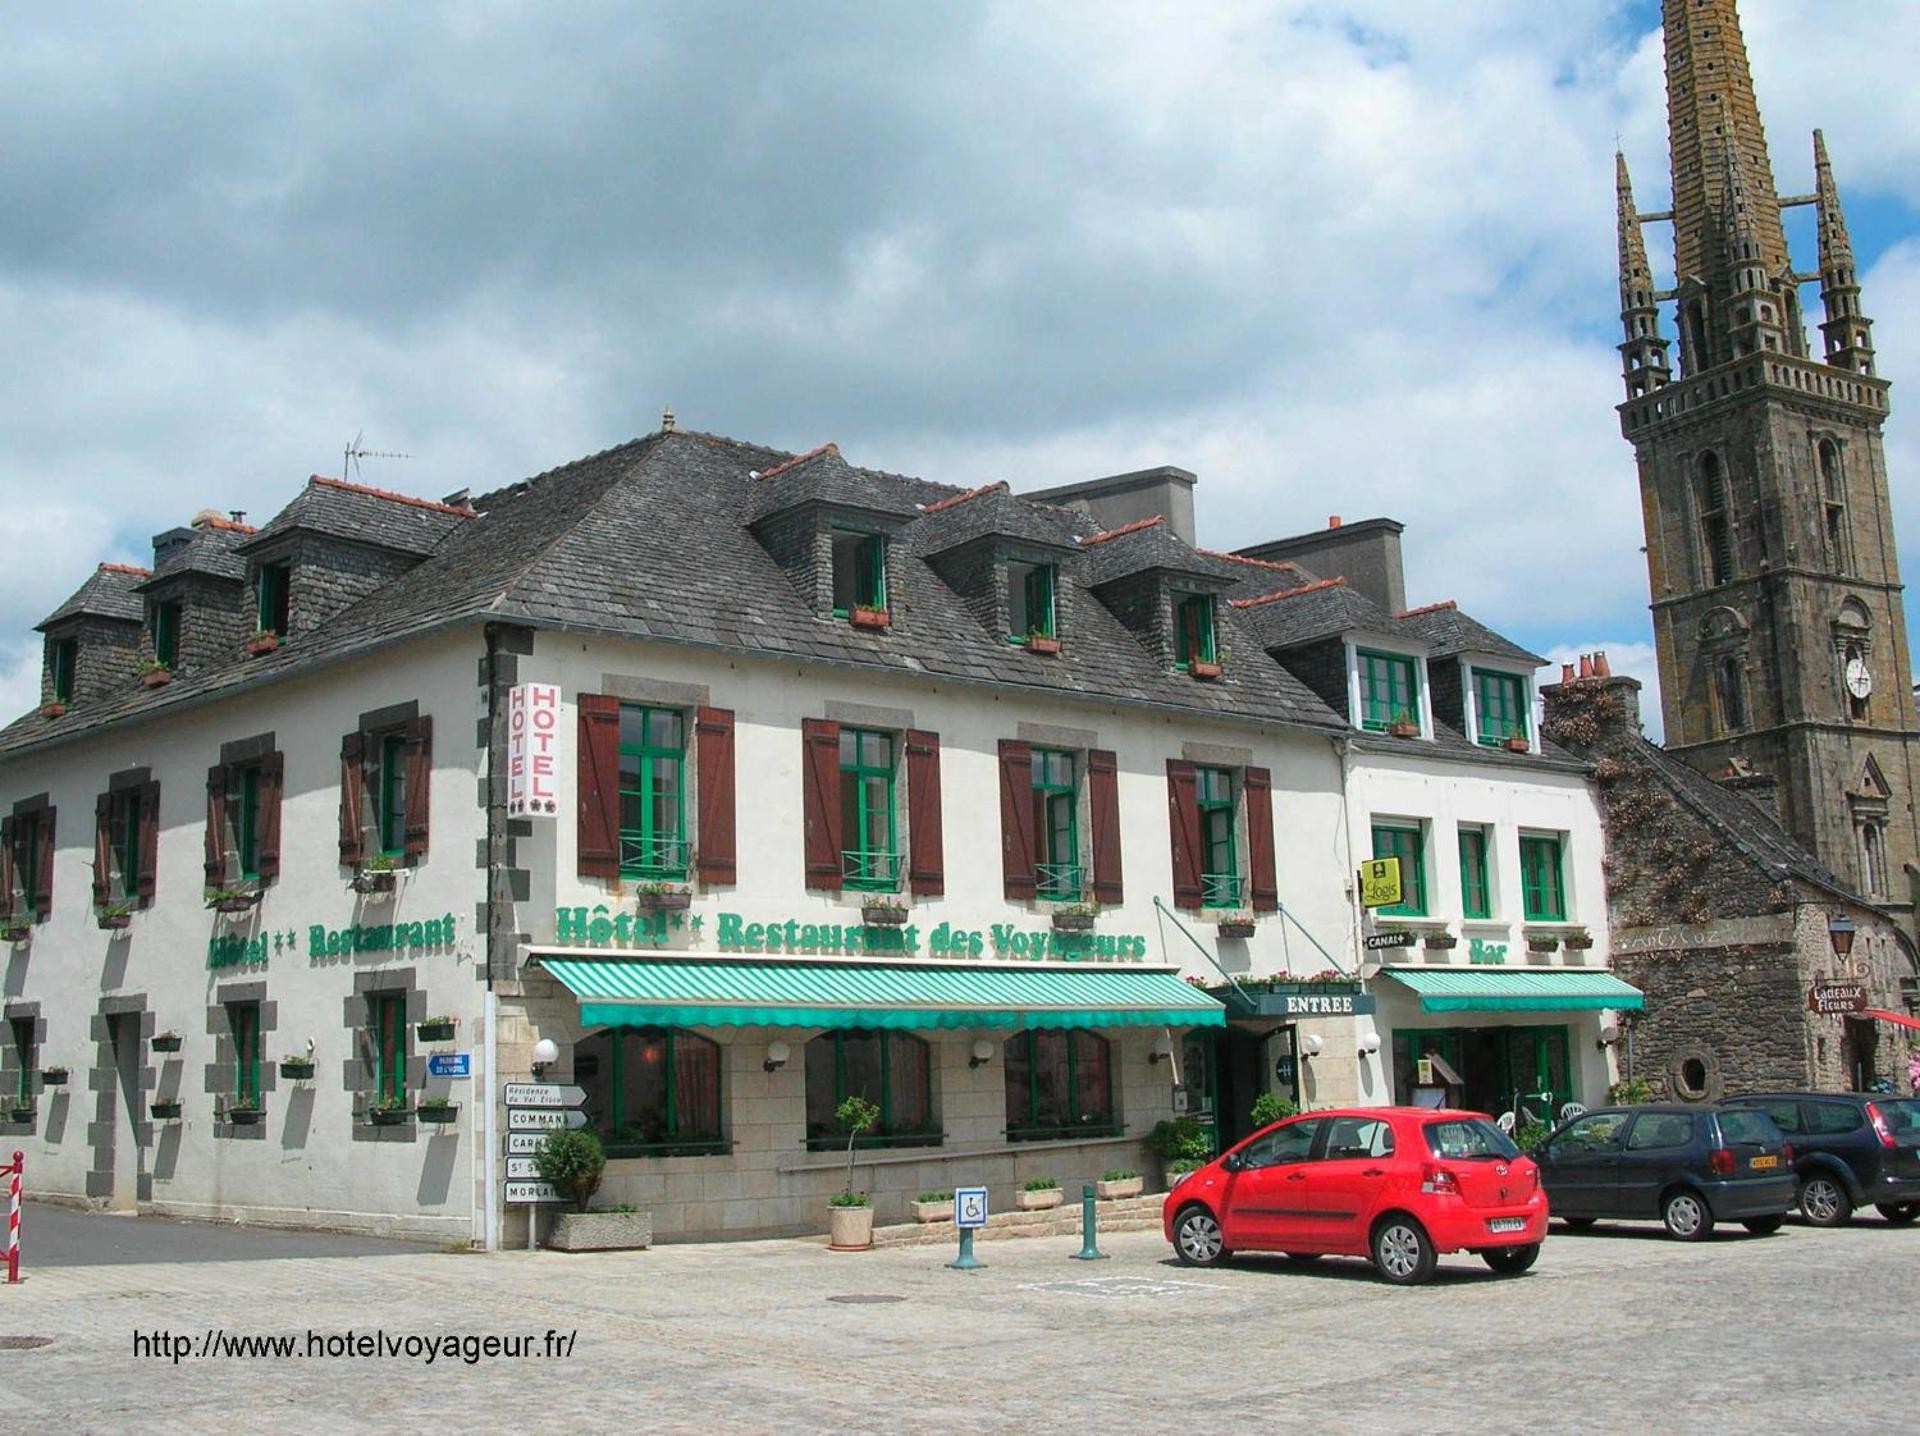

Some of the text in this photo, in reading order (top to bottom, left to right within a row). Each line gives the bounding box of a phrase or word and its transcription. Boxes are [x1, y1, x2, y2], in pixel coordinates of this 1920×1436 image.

[512, 686, 525, 800] HOTEL
[533, 686, 556, 797] HOTEL
[1365, 879, 1398, 901] Logis
[209, 912, 458, 968] Hôtel Restaurant
[555, 904, 1146, 961] Hôtel Restaurant des Voyageurs
[1368, 933, 1405, 948] CANAL+
[1469, 938, 1507, 965] Bar
[1286, 996, 1353, 1013] ENTREE
[510, 1187, 555, 1197] MORLAI
